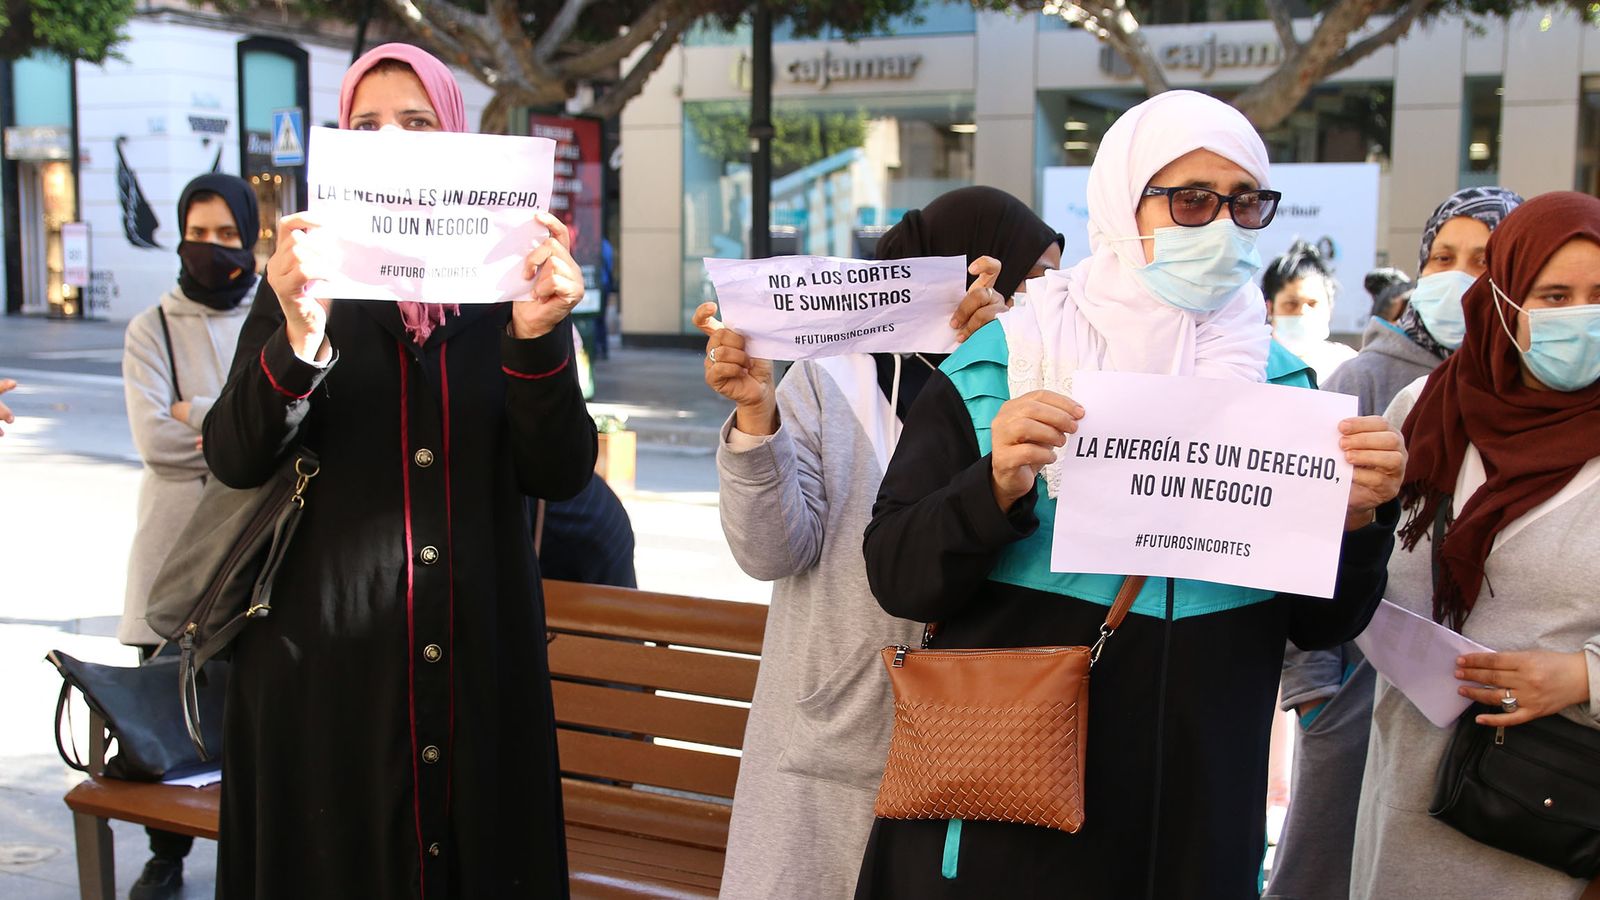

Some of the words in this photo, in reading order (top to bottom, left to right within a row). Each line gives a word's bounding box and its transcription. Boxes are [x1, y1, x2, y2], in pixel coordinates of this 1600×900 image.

[1164, 36, 1284, 79] cajam
[788, 51, 923, 91] cajamar
[318, 184, 336, 200] LA
[419, 189, 438, 207] ES
[443, 190, 463, 206] UN
[372, 216, 392, 234] NO
[398, 217, 420, 236] UN
[425, 217, 489, 236] NEGOCIO
[769, 274, 791, 289] NO
[796, 276, 807, 288] A
[812, 271, 843, 285] LOS
[847, 265, 911, 284] CORTES
[773, 293, 795, 312] DE
[799, 288, 911, 312] SUMINISTROS
[794, 322, 896, 346] #FUTUROSINCORTES
[1075, 436, 1098, 458] LA
[1103, 436, 1181, 463] ENERGÍA
[1186, 441, 1211, 465] ES
[1215, 444, 1242, 469] UN
[1246, 449, 1341, 484] DERECHO,
[1130, 473, 1156, 497] NO
[1161, 476, 1187, 498] UN
[1190, 479, 1273, 508] NEGOCIO
[1135, 533, 1251, 558] #FUTUROSINCORTES
